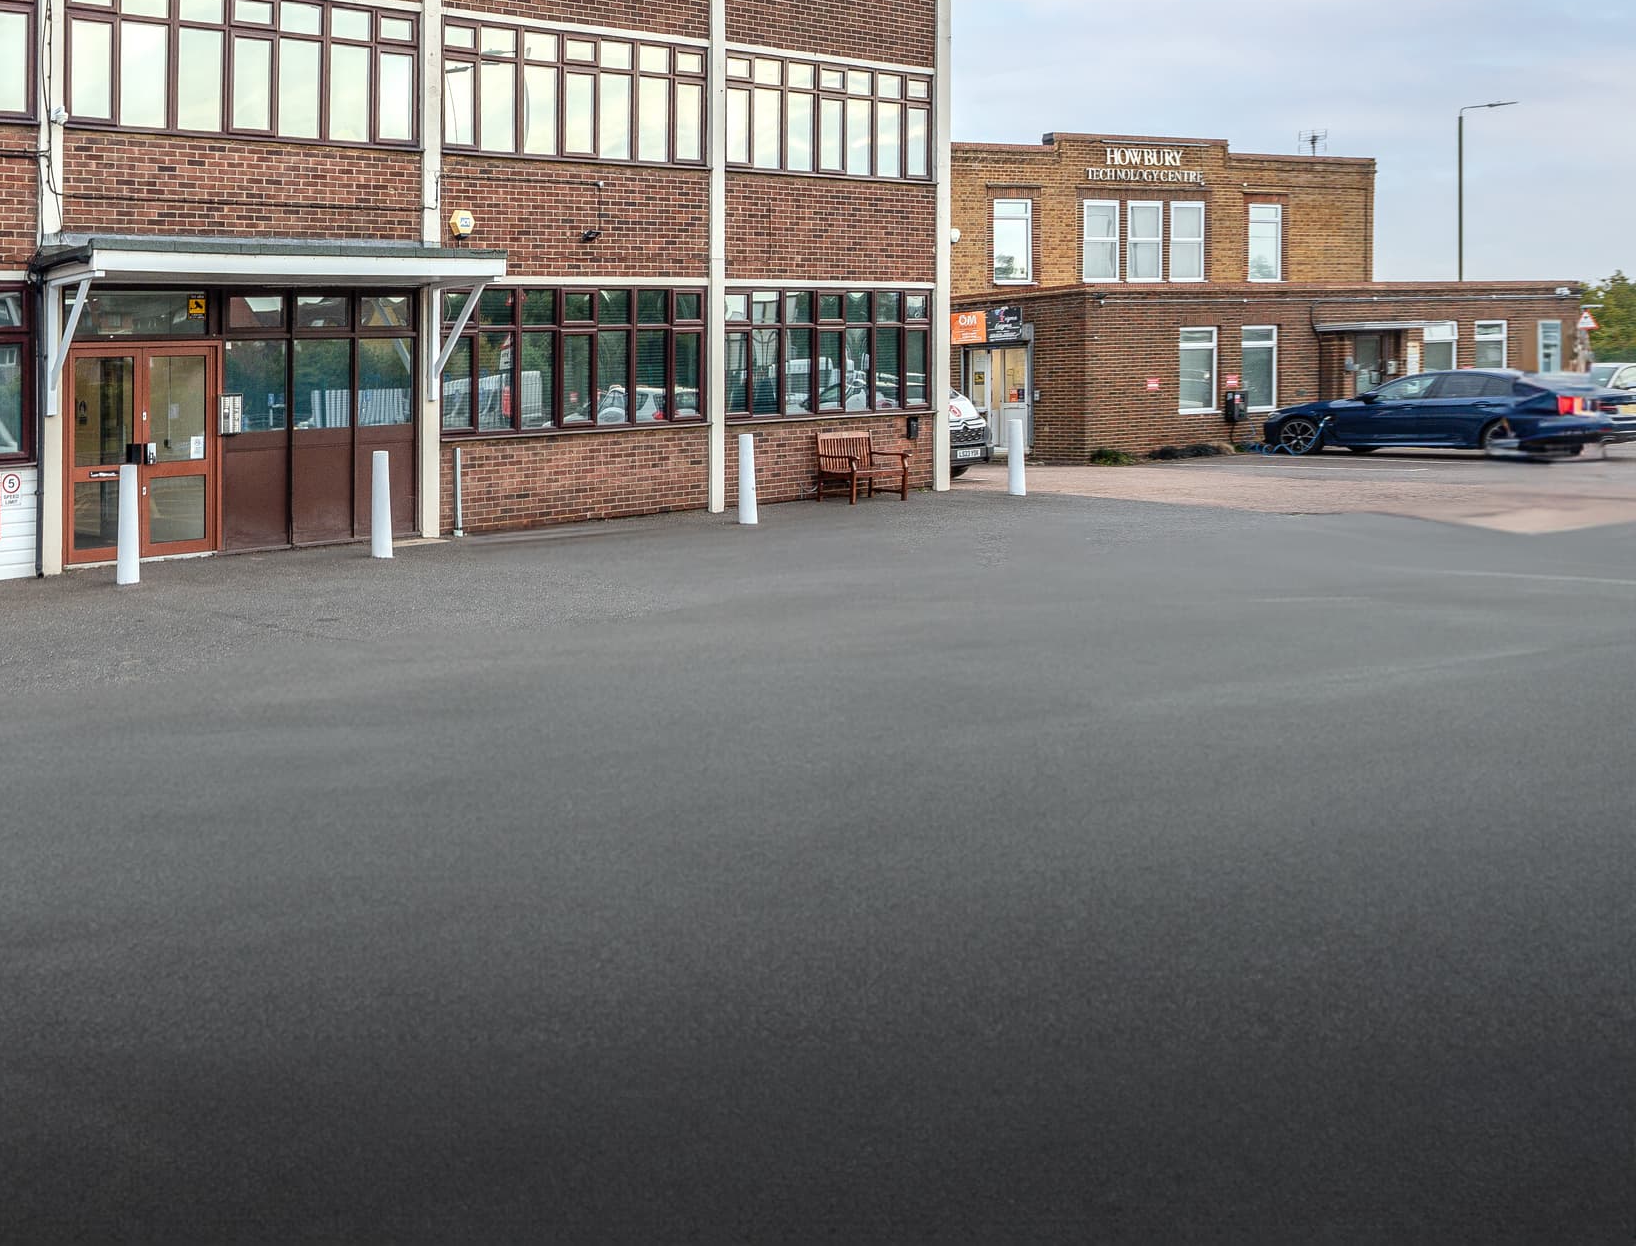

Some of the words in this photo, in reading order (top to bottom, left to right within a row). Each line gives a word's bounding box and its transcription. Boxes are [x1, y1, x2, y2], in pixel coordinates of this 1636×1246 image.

[1105, 147, 1183, 166] HOWBURY
[1086, 167, 1159, 182] TECHNOLOGY
[1160, 170, 1203, 182] CENTRE
[8, 478, 15, 489] 5
